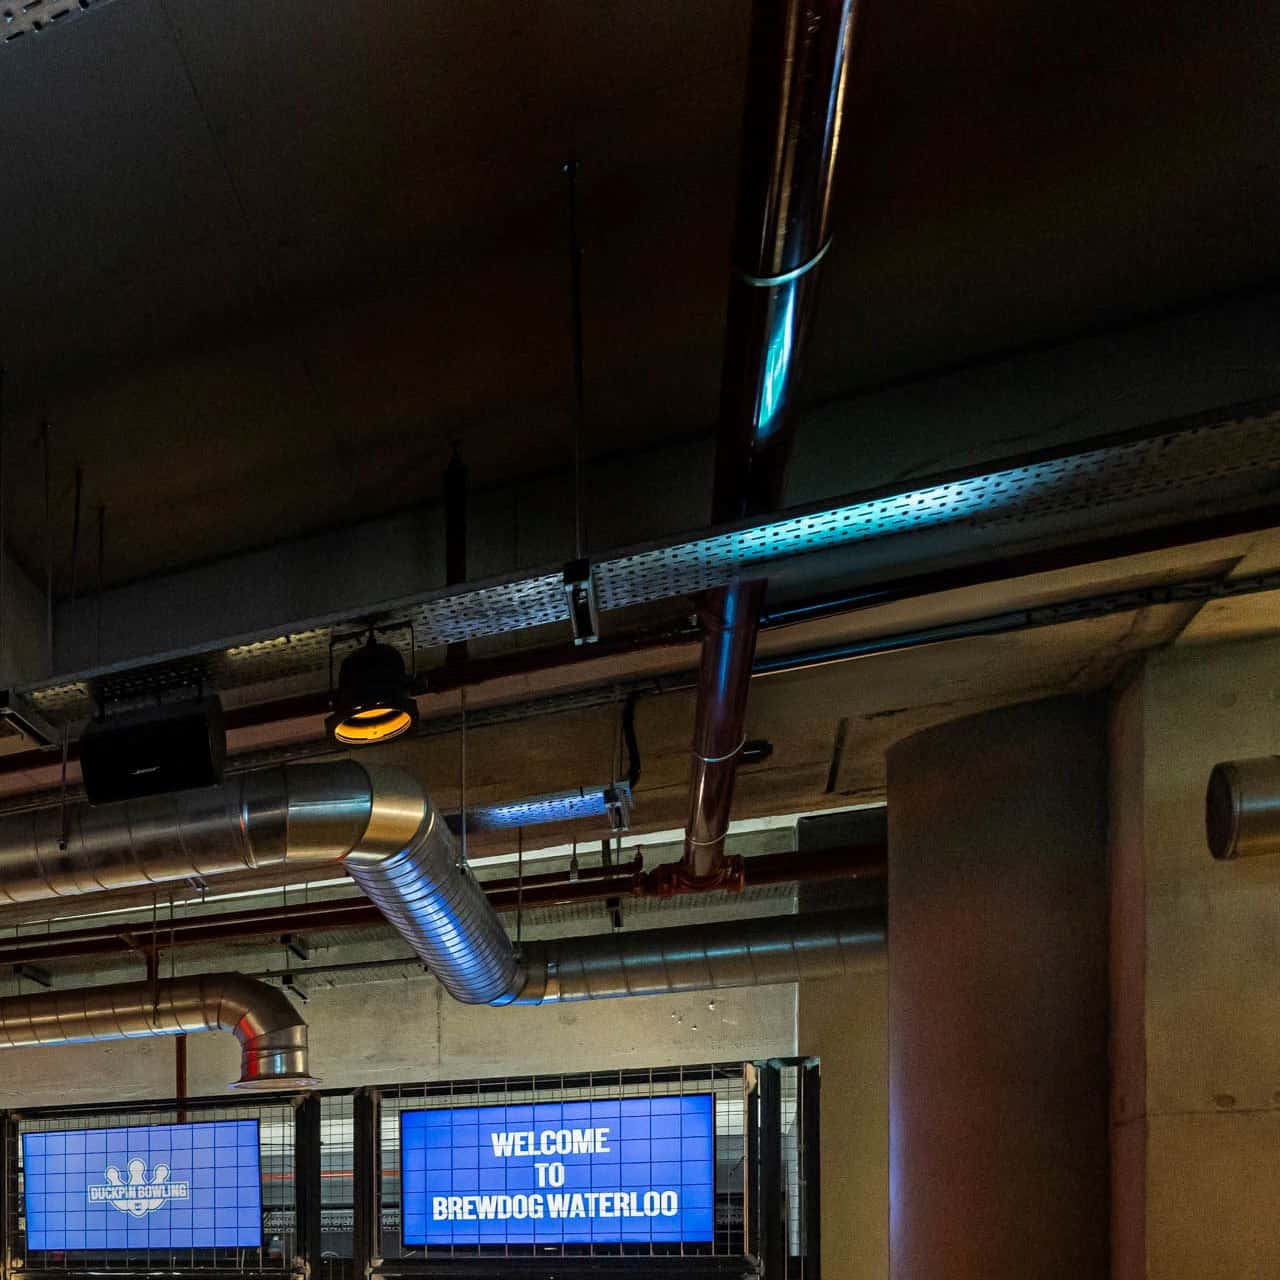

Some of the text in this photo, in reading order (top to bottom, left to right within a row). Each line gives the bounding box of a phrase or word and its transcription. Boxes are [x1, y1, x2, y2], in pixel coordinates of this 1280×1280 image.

[491, 1128, 610, 1157] WELCOME
[534, 1162, 565, 1188] TO
[90, 1184, 187, 1200] DUCKPIN BOWLING
[432, 1190, 678, 1220] BREWDOG WATERLOO
